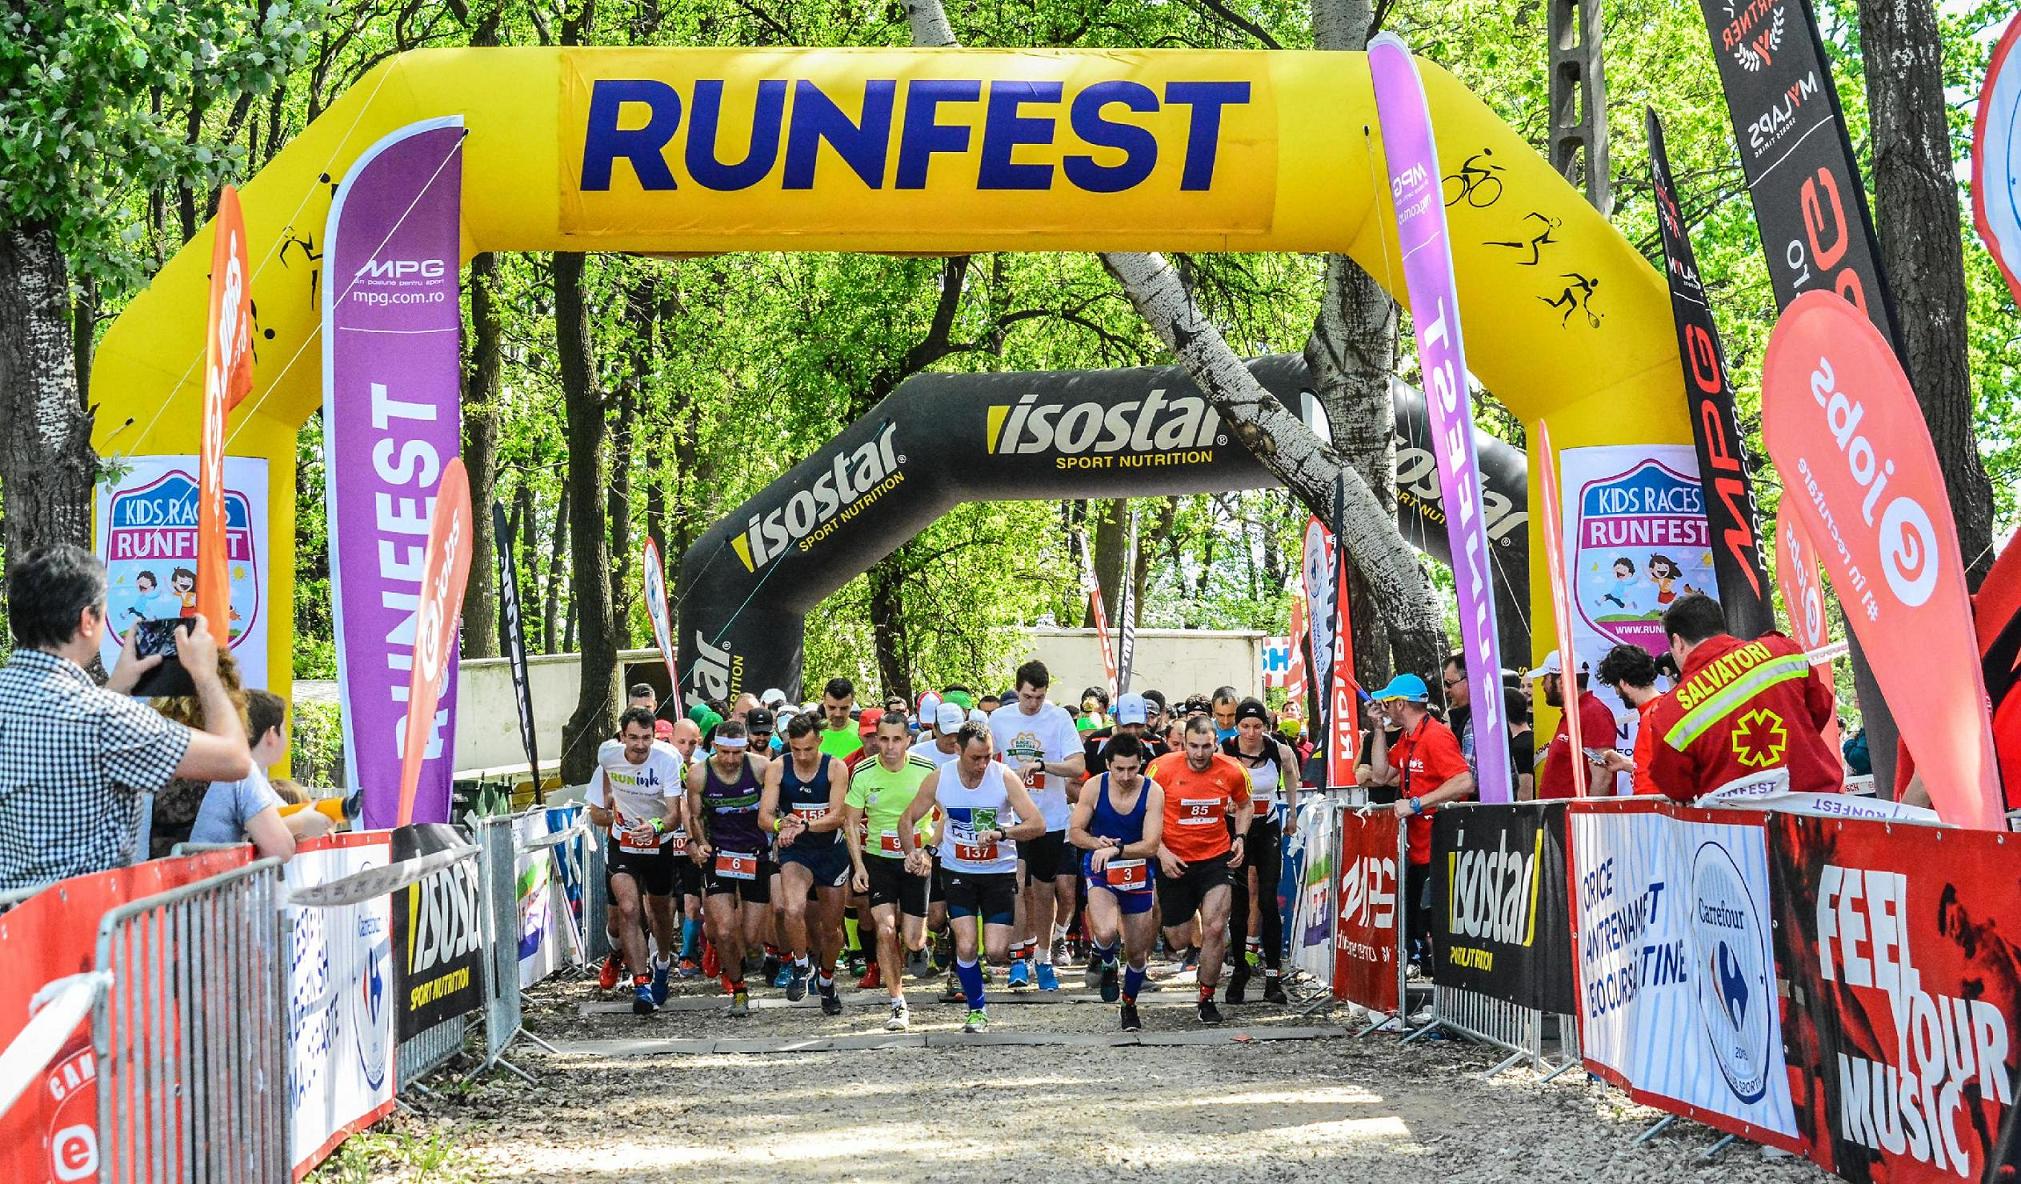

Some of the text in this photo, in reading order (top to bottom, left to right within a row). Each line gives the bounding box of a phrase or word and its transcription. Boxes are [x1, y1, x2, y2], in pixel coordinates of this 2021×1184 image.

[580, 79, 1251, 193] RUNFEST
[355, 259, 445, 278] MPG
[353, 290, 445, 307] mpg.com.ro
[1056, 450, 1213, 469] SPORT NUTRITION
[1685, 323, 1761, 601] MPG
[126, 498, 165, 525] KIDS
[749, 421, 898, 569] isostar
[799, 470, 906, 552] SPORT NUTRITION
[1598, 486, 1701, 514] KIDS RACES
[117, 531, 243, 558] RUNFT
[1590, 519, 1710, 546] RUNFEST
[1676, 642, 1772, 711] SALVATORI
[1190, 804, 1210, 816] 85
[732, 858, 741, 870] 6
[962, 847, 990, 859] 137
[1123, 867, 1133, 881] 3
[1453, 829, 1535, 946] isostar
[1583, 857, 1613, 913] ORICE
[1698, 896, 1745, 930] Carrefour
[1816, 864, 1921, 993] FEEL
[1641, 938, 1687, 988] TINE
[410, 965, 470, 1012] SPORT NUTRITION
[1887, 987, 2013, 1106] YOUR
[1838, 1051, 1970, 1178] MUSIC
